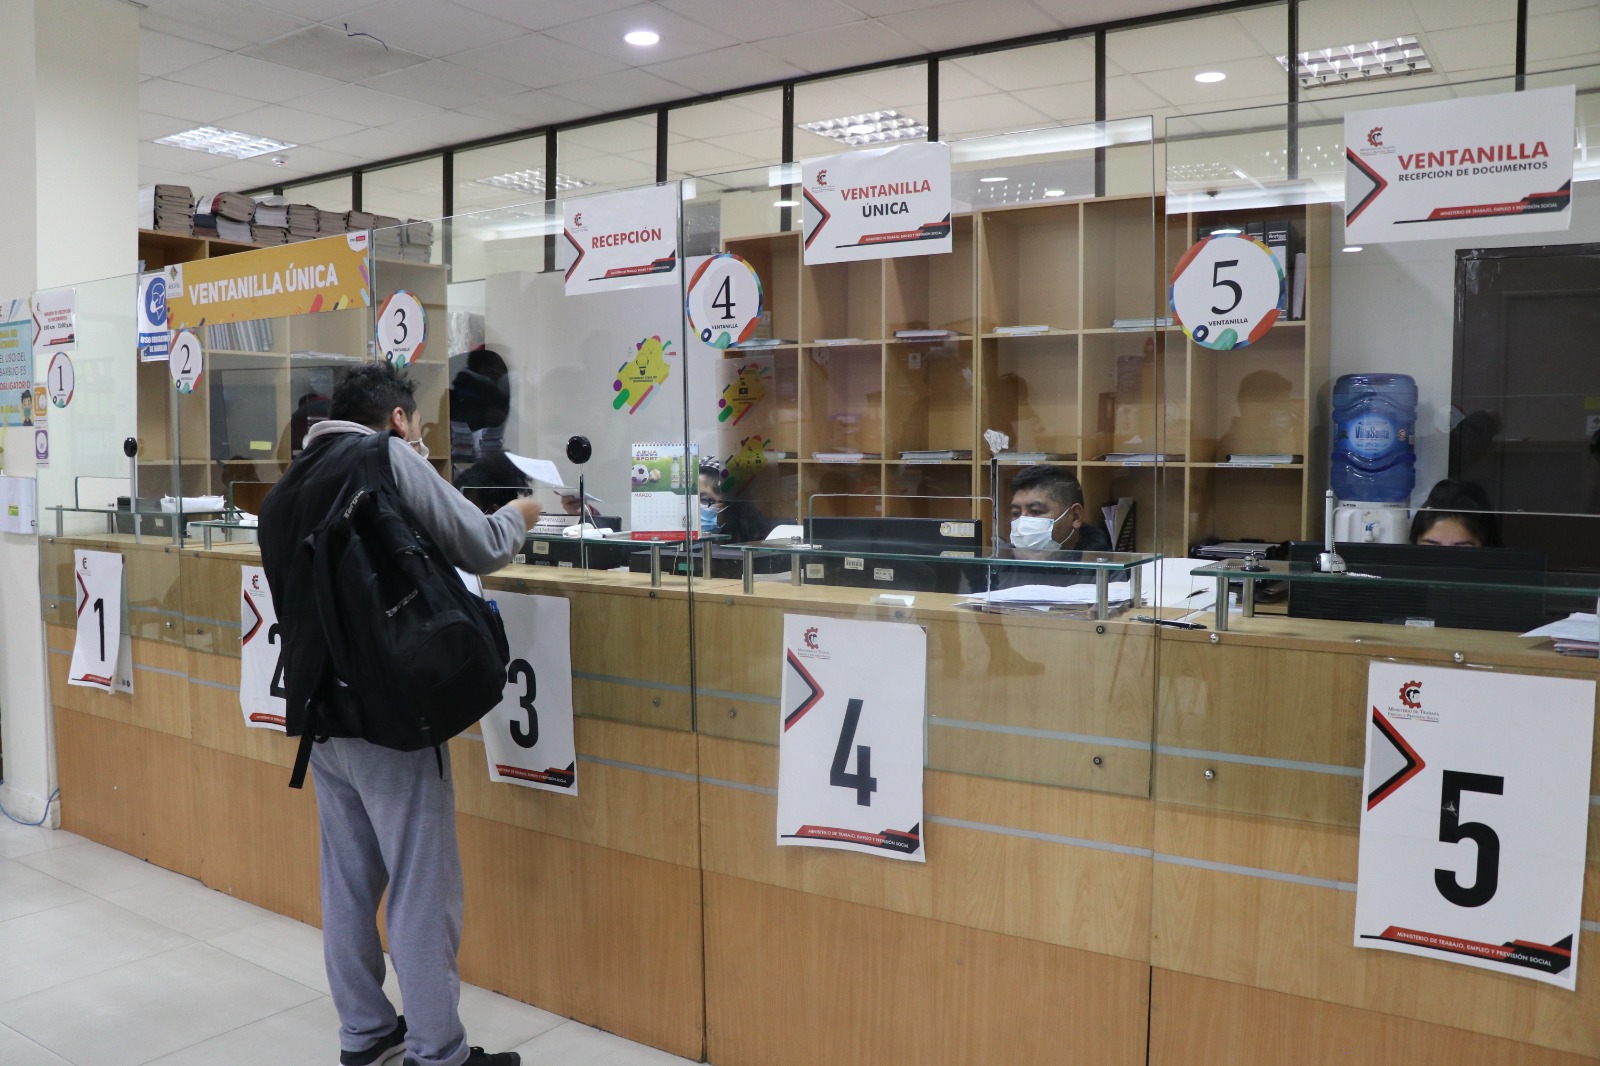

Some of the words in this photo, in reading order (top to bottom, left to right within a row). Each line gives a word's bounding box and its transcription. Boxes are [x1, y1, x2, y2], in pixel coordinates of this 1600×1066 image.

[1398, 141, 1549, 170] VENTANILLA
[1456, 168, 1469, 176] DE
[1472, 161, 1548, 175] DOCUMENTOS
[840, 180, 932, 201] VENTANILLA
[862, 202, 909, 218] ÚNICA
[592, 227, 662, 249] RECEPCIÓN
[188, 271, 283, 306] VENTANILLA
[286, 263, 338, 294] ÚNICA
[712, 276, 736, 319] 4
[1211, 260, 1242, 315] 5
[394, 308, 407, 344] 3
[1208, 318, 1248, 326] VENTANILLA
[6, 353, 16, 363] USO
[17, 352, 26, 362] DEL
[20, 366, 26, 374] ES
[180, 344, 191, 374] 2
[0, 380, 30, 389] OBLIGATORIO
[58, 365, 64, 391] 1
[94, 598, 105, 662] 1
[268, 623, 287, 700] 2
[508, 658, 538, 748] 3
[830, 698, 877, 807] 4
[1434, 770, 1504, 908] 5
[1397, 931, 1429, 942] MINISTERIO
[1439, 938, 1465, 949] TRABAJO,
[1467, 944, 1490, 954] EMPLEO
[1496, 950, 1528, 961] PREVISIÓN
[1530, 956, 1552, 967] SOCIAL
